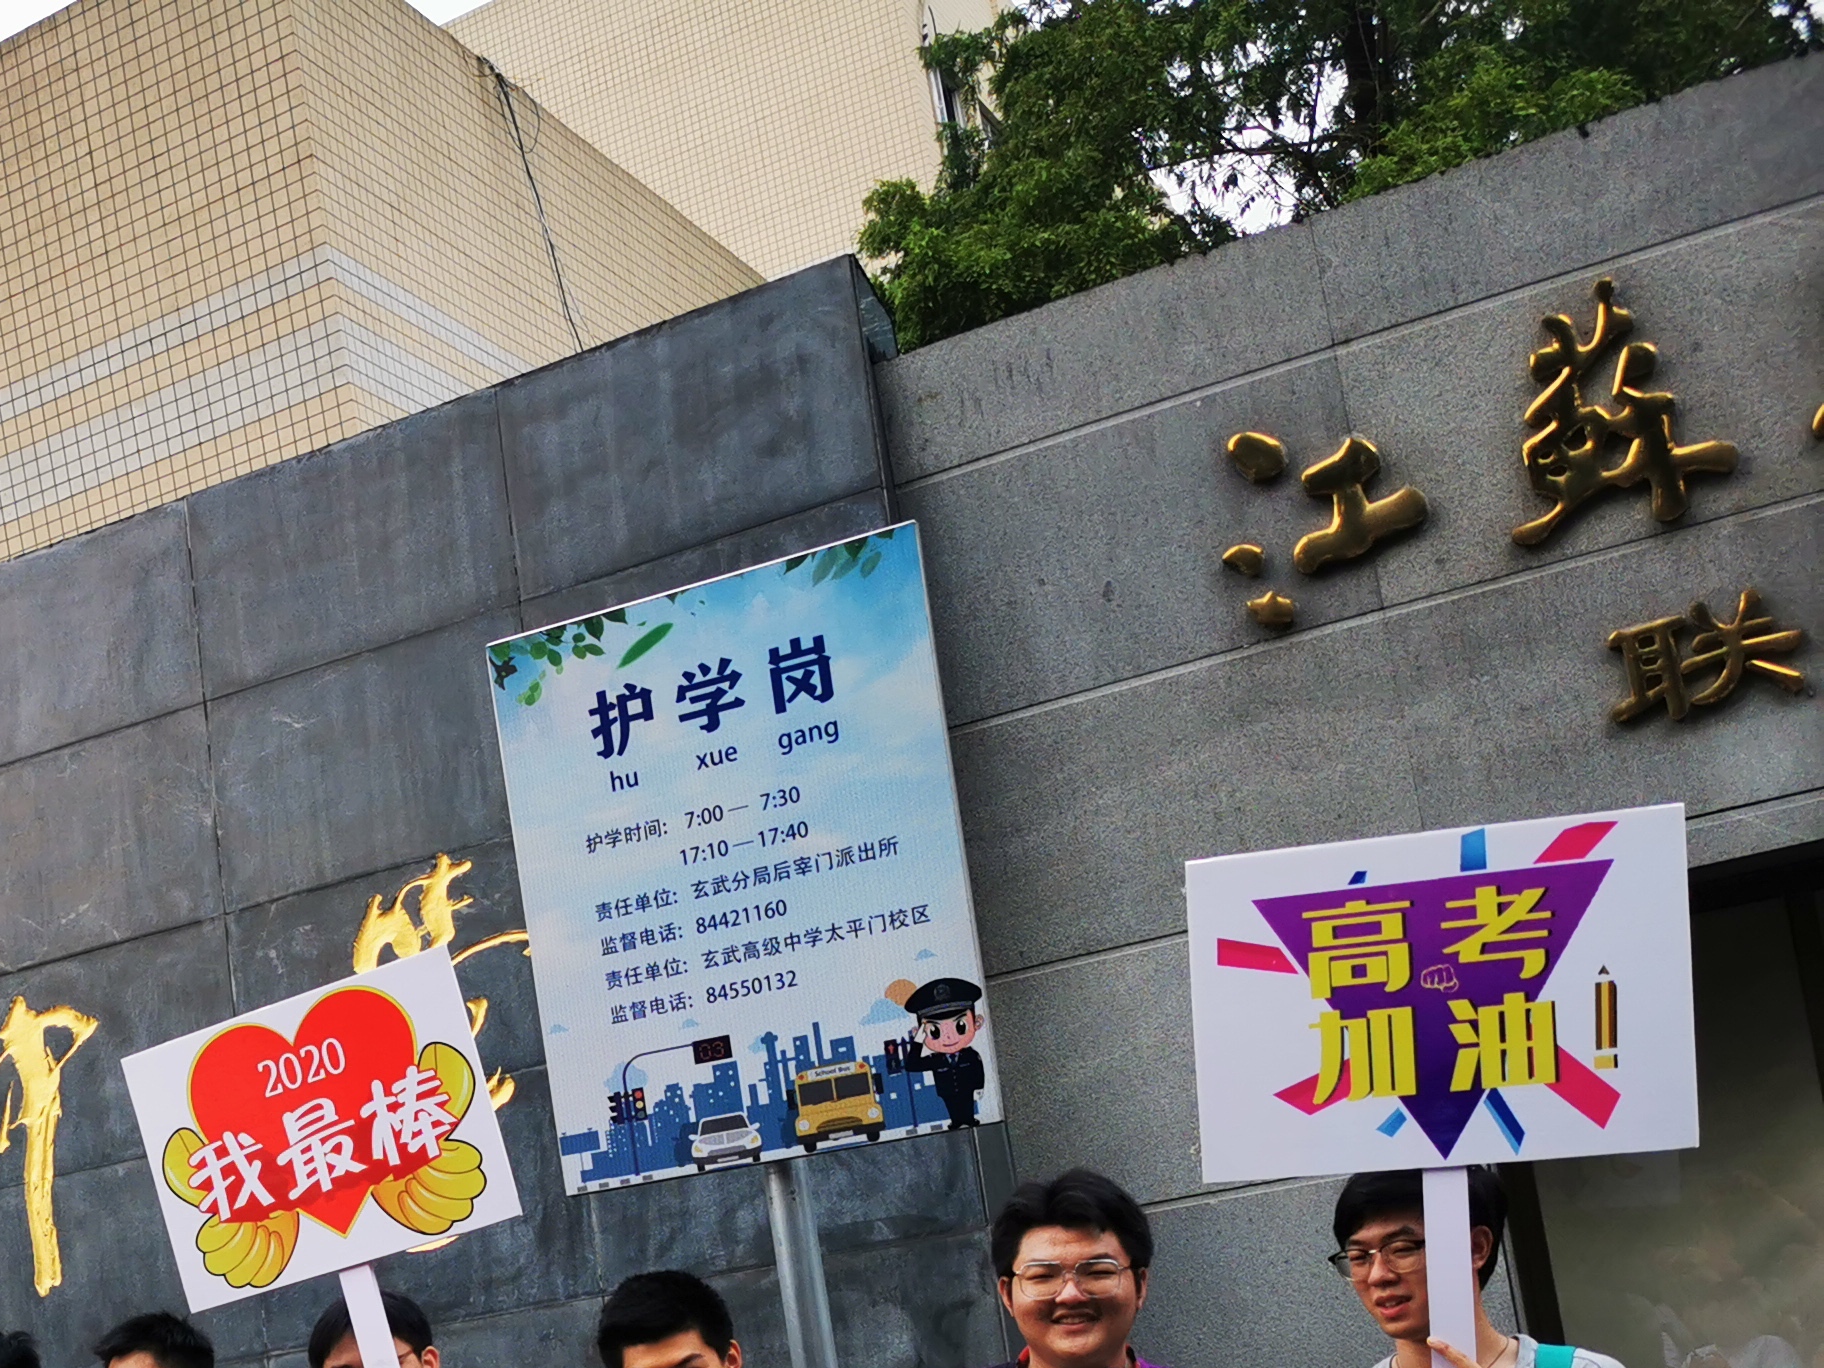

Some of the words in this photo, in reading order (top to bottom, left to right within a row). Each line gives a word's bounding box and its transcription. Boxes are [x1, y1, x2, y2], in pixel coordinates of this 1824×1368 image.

[588, 635, 834, 759] 护学岗
[610, 771, 639, 792] hu
[696, 746, 738, 770] xue
[778, 720, 839, 755] gang
[586, 819, 668, 854] 护学时间：
[595, 889, 678, 922] 责任单位：
[691, 835, 899, 900] 玄武分局后宰门派出所
[601, 923, 683, 956] 监督电话：
[696, 899, 787, 935] 84421160
[605, 958, 688, 991] 责任单位：
[701, 904, 931, 970] 玄武高级中学太平门校区
[1302, 885, 1555, 1000] 高考
[611, 992, 694, 1025] 监督电话：
[706, 970, 798, 1003] 84550132
[257, 1038, 346, 1098] 2020
[815, 1067, 837, 1078] School
[838, 1065, 851, 1073] Bus
[1308, 991, 1560, 1105] 加油
[188, 1065, 460, 1222] 我最棒
